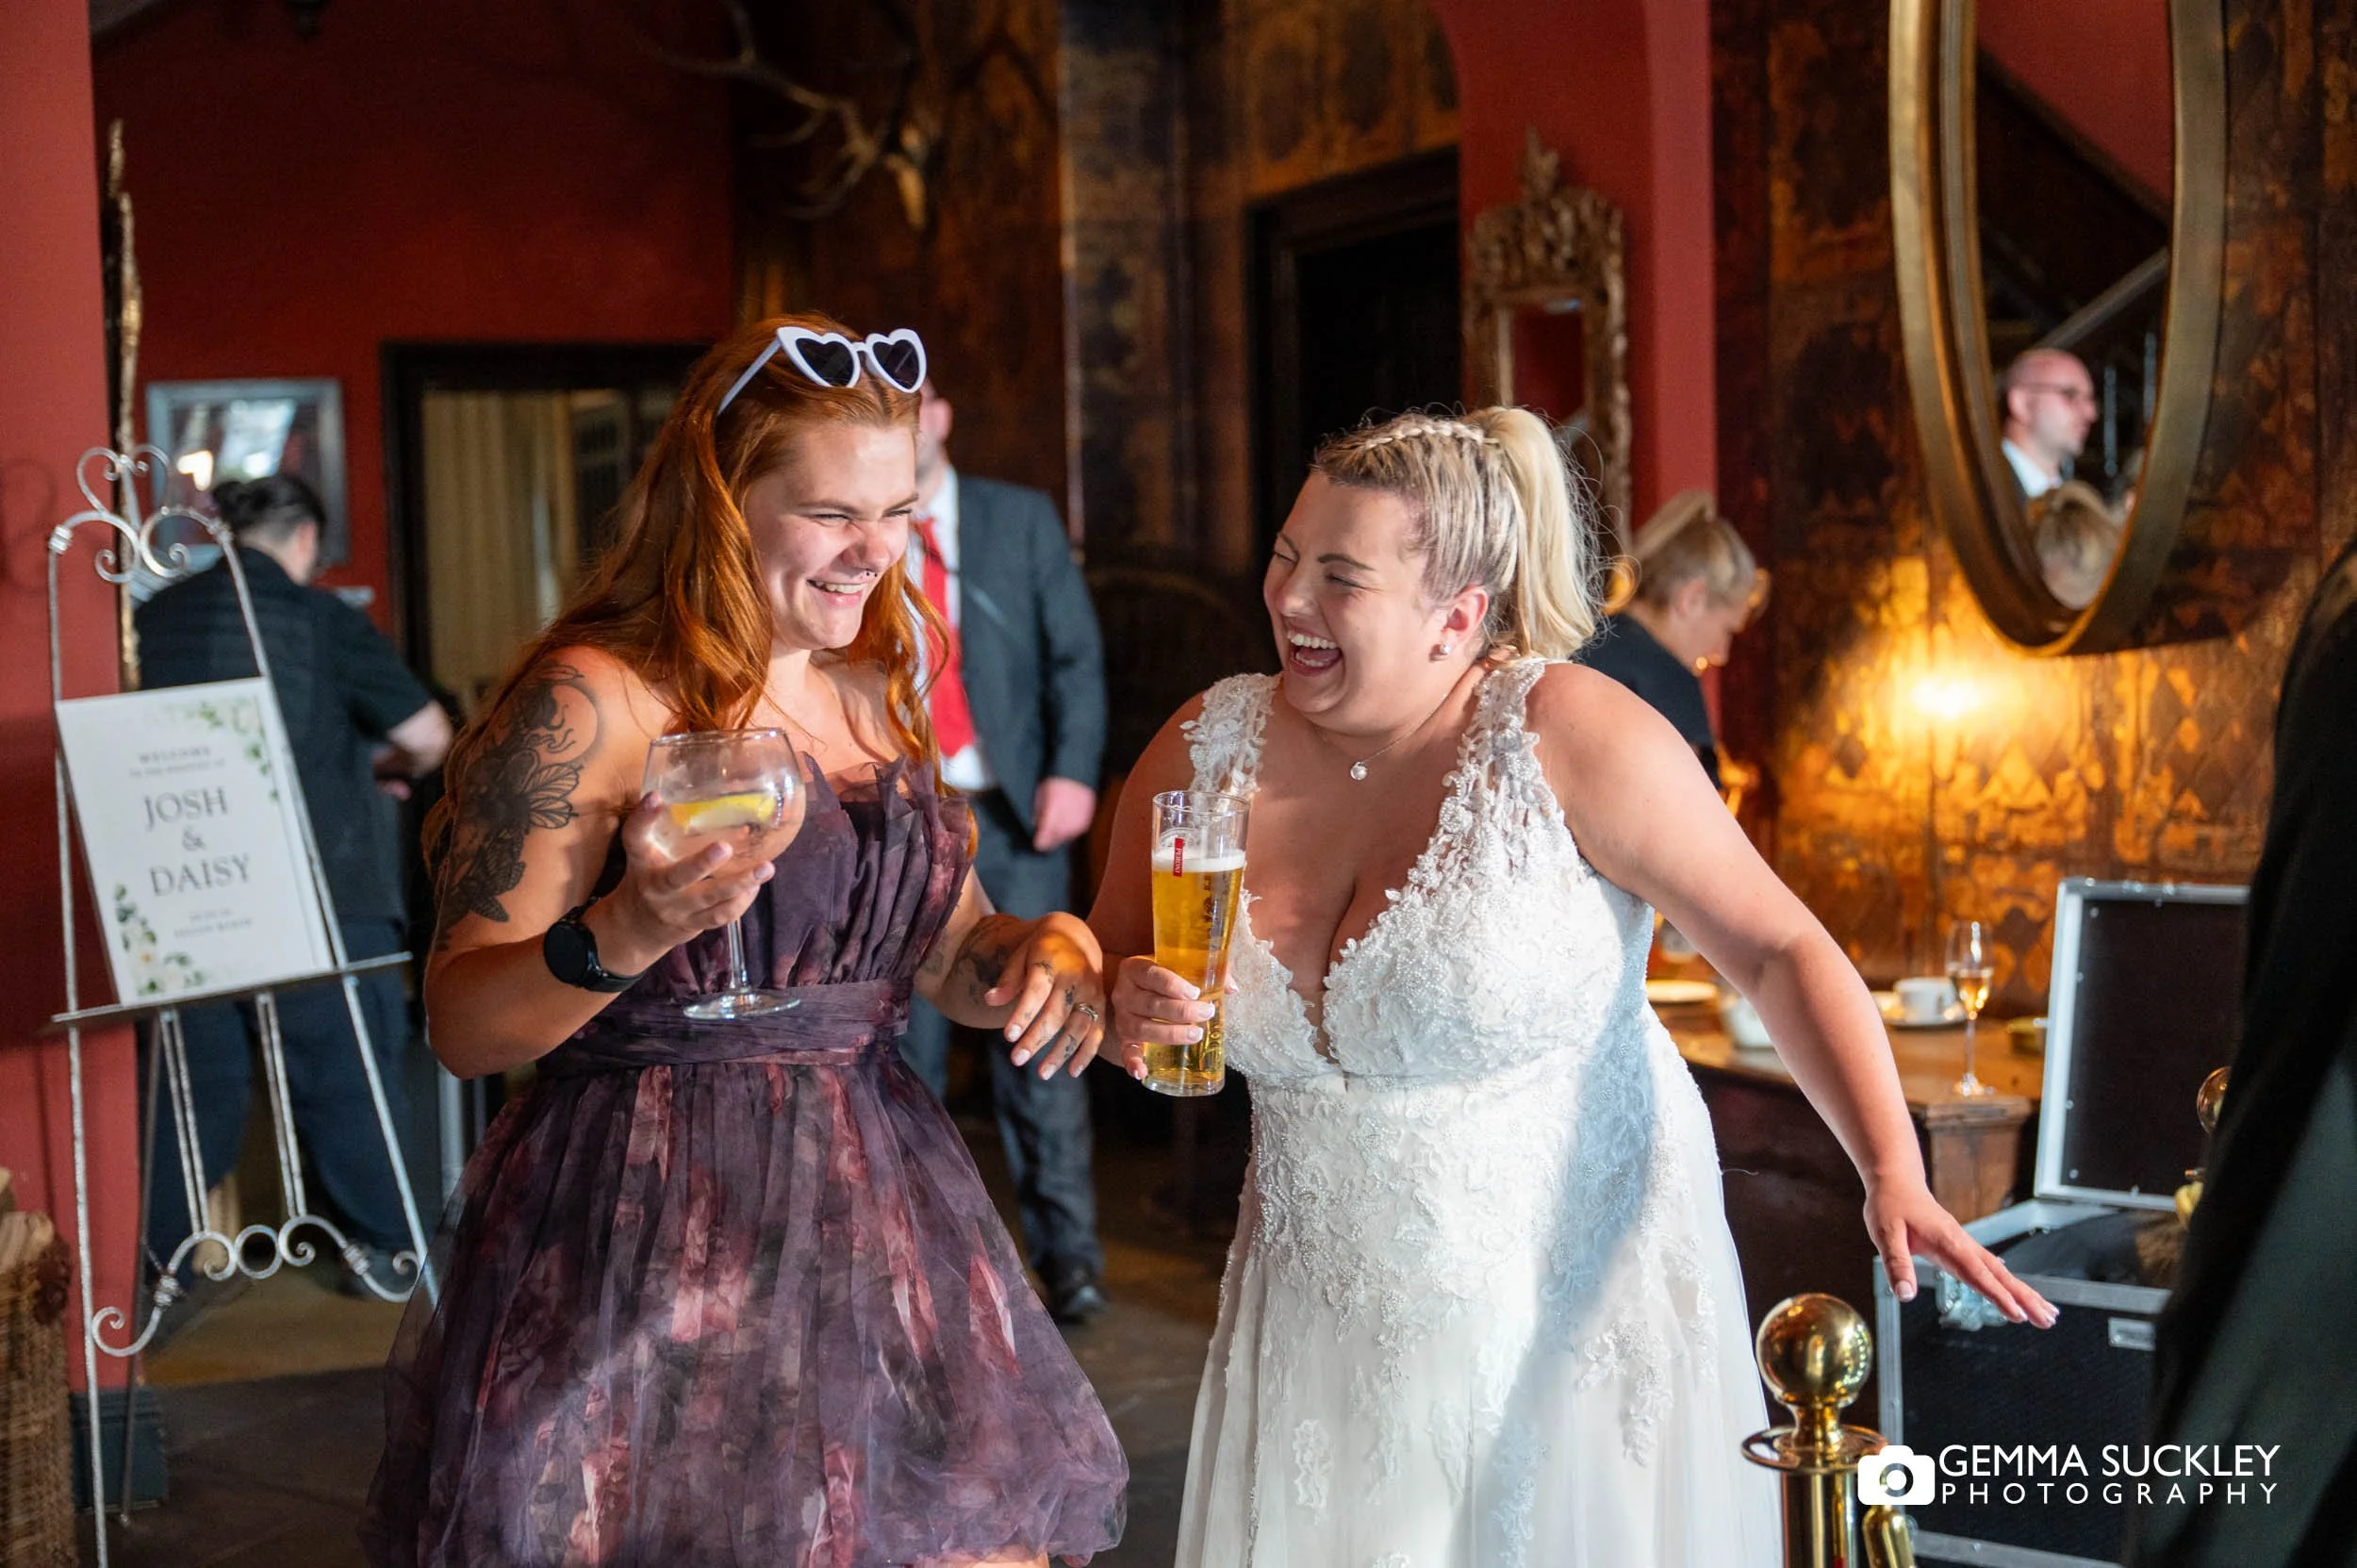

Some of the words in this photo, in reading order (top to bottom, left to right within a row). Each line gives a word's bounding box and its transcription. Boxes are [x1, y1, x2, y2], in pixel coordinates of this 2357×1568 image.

[143, 786, 228, 832] JOSH
[181, 825, 206, 851] &
[148, 852, 250, 897] DAISY
